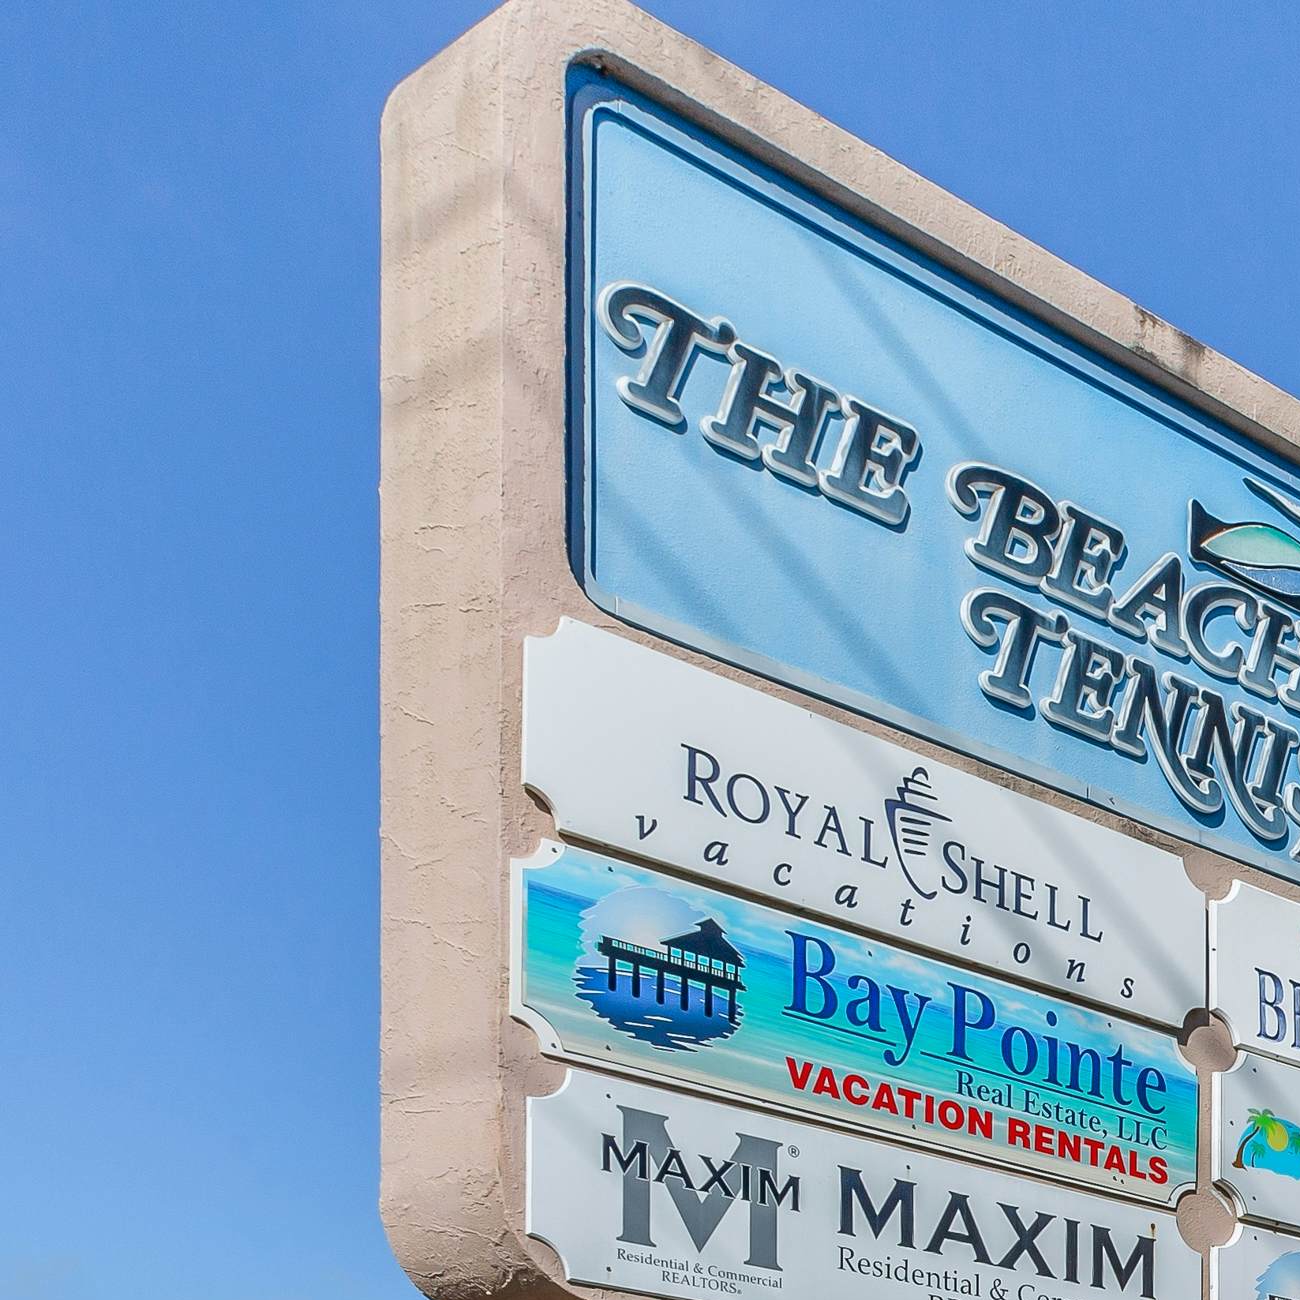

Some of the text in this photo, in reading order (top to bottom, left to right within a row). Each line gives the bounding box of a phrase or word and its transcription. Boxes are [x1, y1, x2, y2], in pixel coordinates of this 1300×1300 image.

[600, 280, 921, 531] THE
[680, 742, 1104, 944] ROYAL SHELL
[783, 929, 1168, 1115] Bay Pointe
[601, 1131, 800, 1213] MAXIM
[784, 1056, 1169, 1186] VACATION RENTALS
[956, 1070, 1169, 1151] Real Estate, LLC
[616, 1247, 783, 1290] Residential & Commercial
[837, 1164, 1157, 1300] MAXIM
[837, 1245, 981, 1298] Residential
